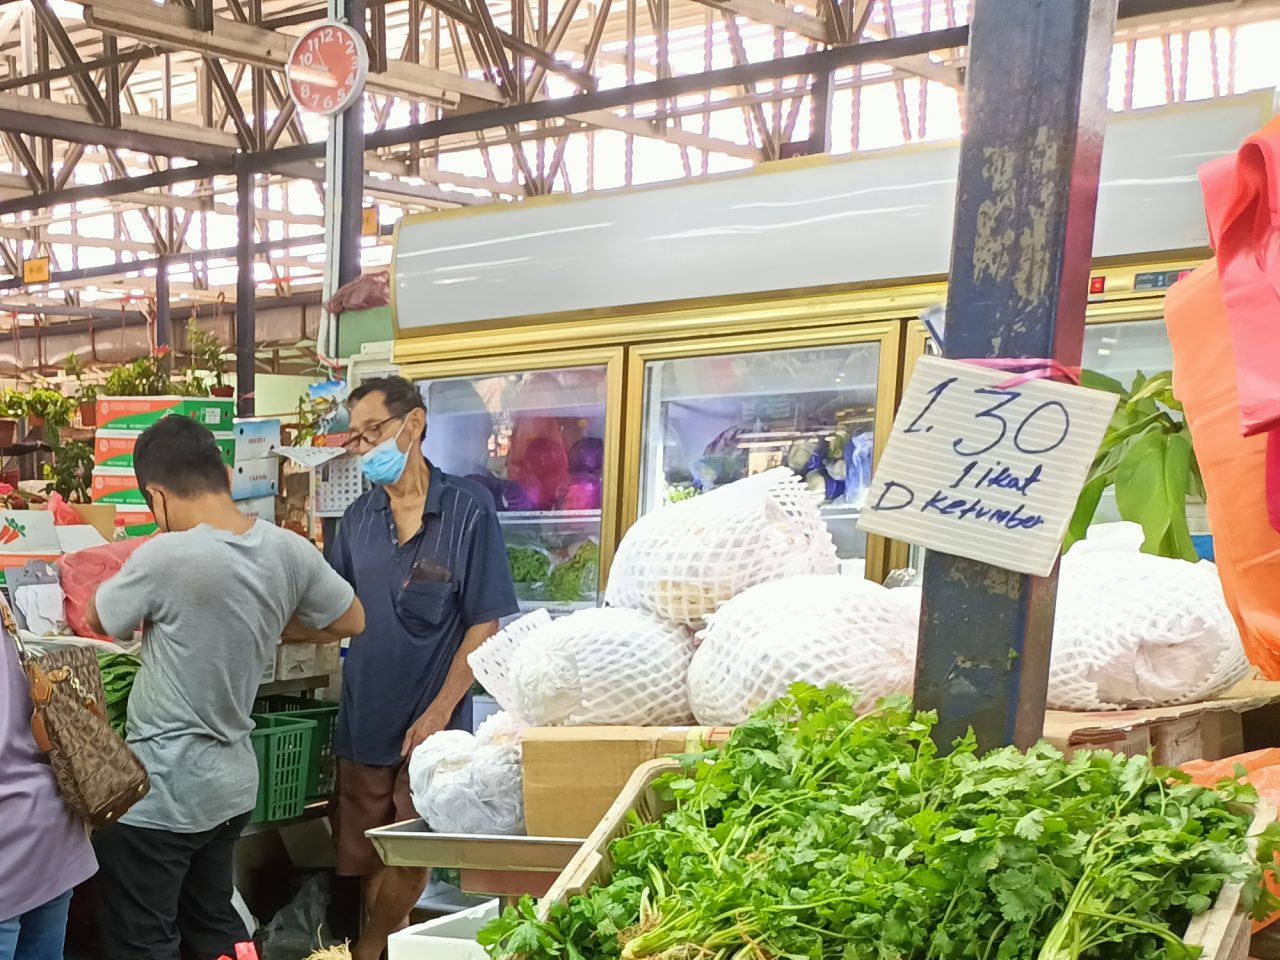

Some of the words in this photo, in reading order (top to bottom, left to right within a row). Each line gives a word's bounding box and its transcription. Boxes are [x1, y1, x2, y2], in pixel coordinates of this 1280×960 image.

[319, 28, 334, 44] 12
[337, 31, 343, 45] 1
[307, 37, 319, 52] 11
[346, 40, 355, 54] 2
[299, 52, 313, 67] 10
[351, 57, 358, 70] 3
[345, 72, 354, 86] 4
[300, 84, 311, 99] 8
[337, 88, 346, 102] 5
[312, 94, 321, 107] 7
[323, 96, 333, 109] 6
[871, 480, 915, 511] D
